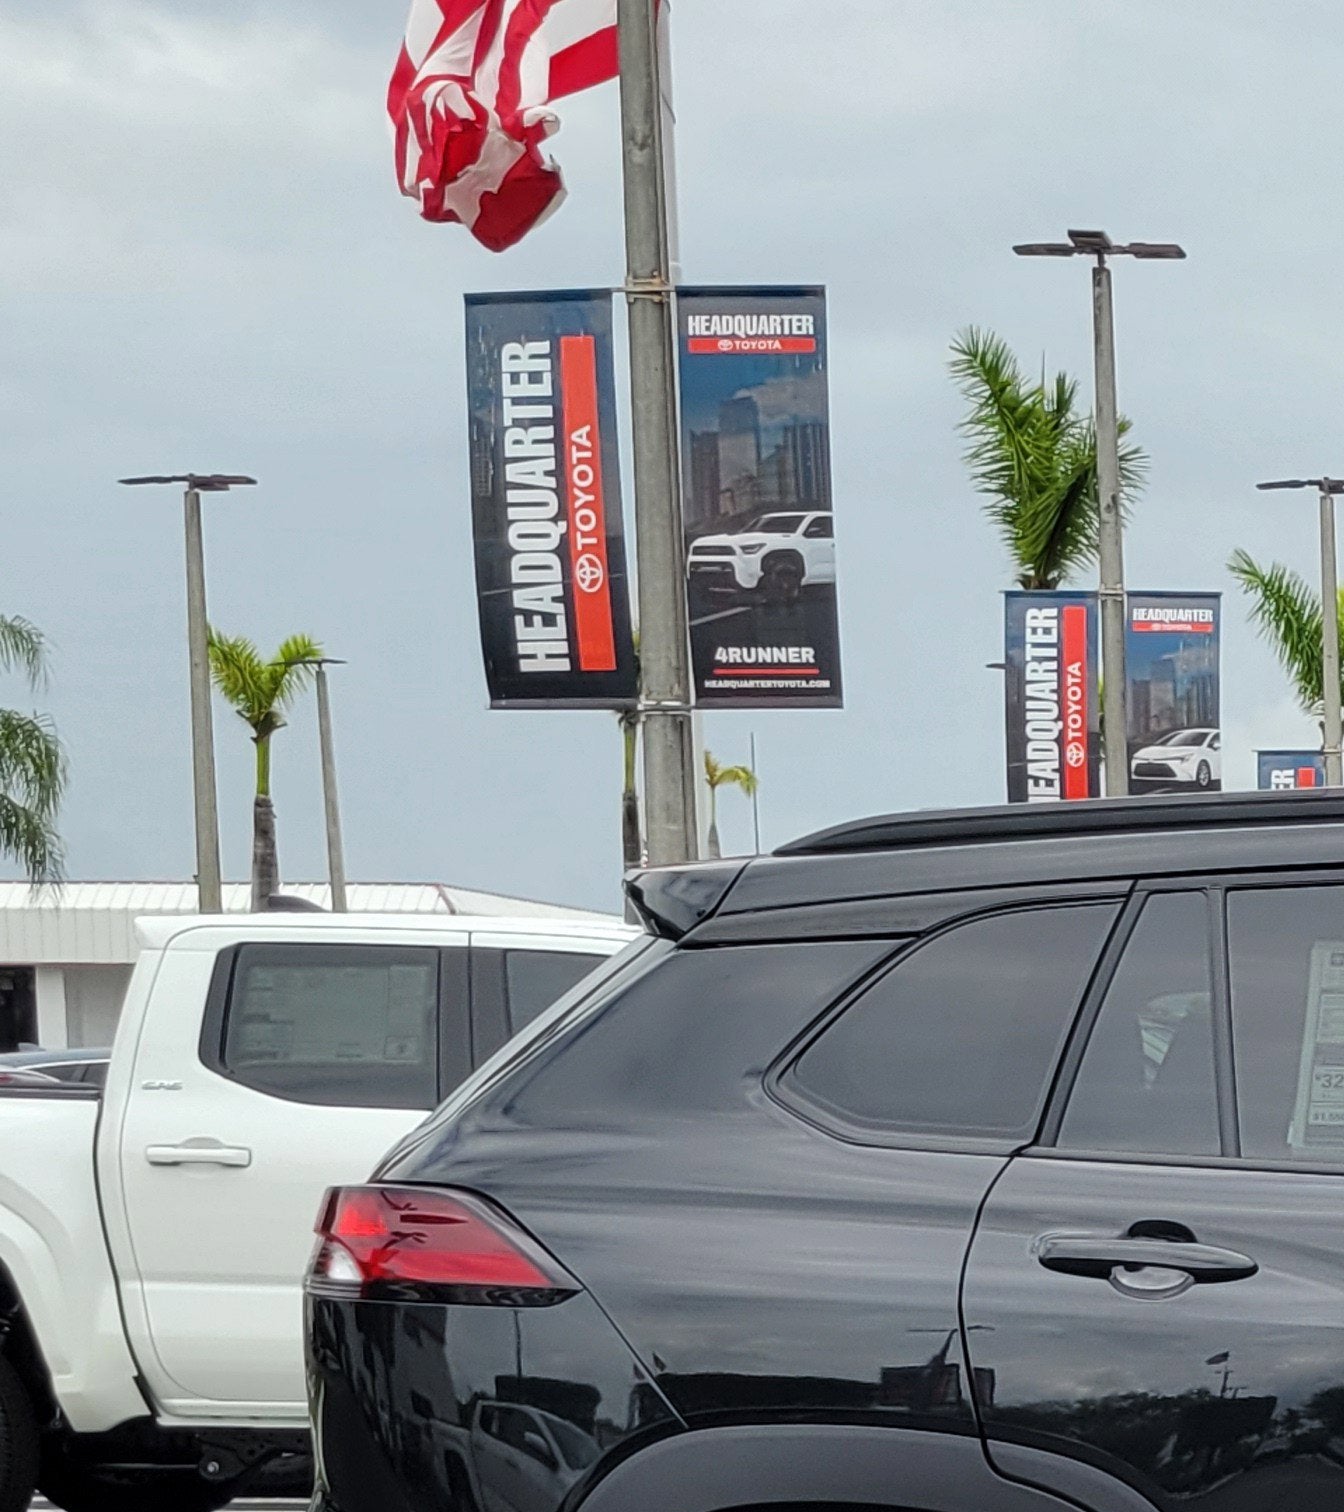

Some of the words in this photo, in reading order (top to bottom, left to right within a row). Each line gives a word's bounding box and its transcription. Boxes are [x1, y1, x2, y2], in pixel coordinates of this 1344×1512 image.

[688, 315, 814, 338] HEADQUARTER
[735, 340, 782, 350] TOYOTA
[572, 425, 597, 551] TOYOTA
[502, 340, 572, 672] HEADQUARTER
[1133, 608, 1214, 623] HEADQUARTER
[714, 647, 815, 663] 4RUNNER
[1067, 662, 1083, 739] TOYOTA
[1322, 1073, 1344, 1088] 32
